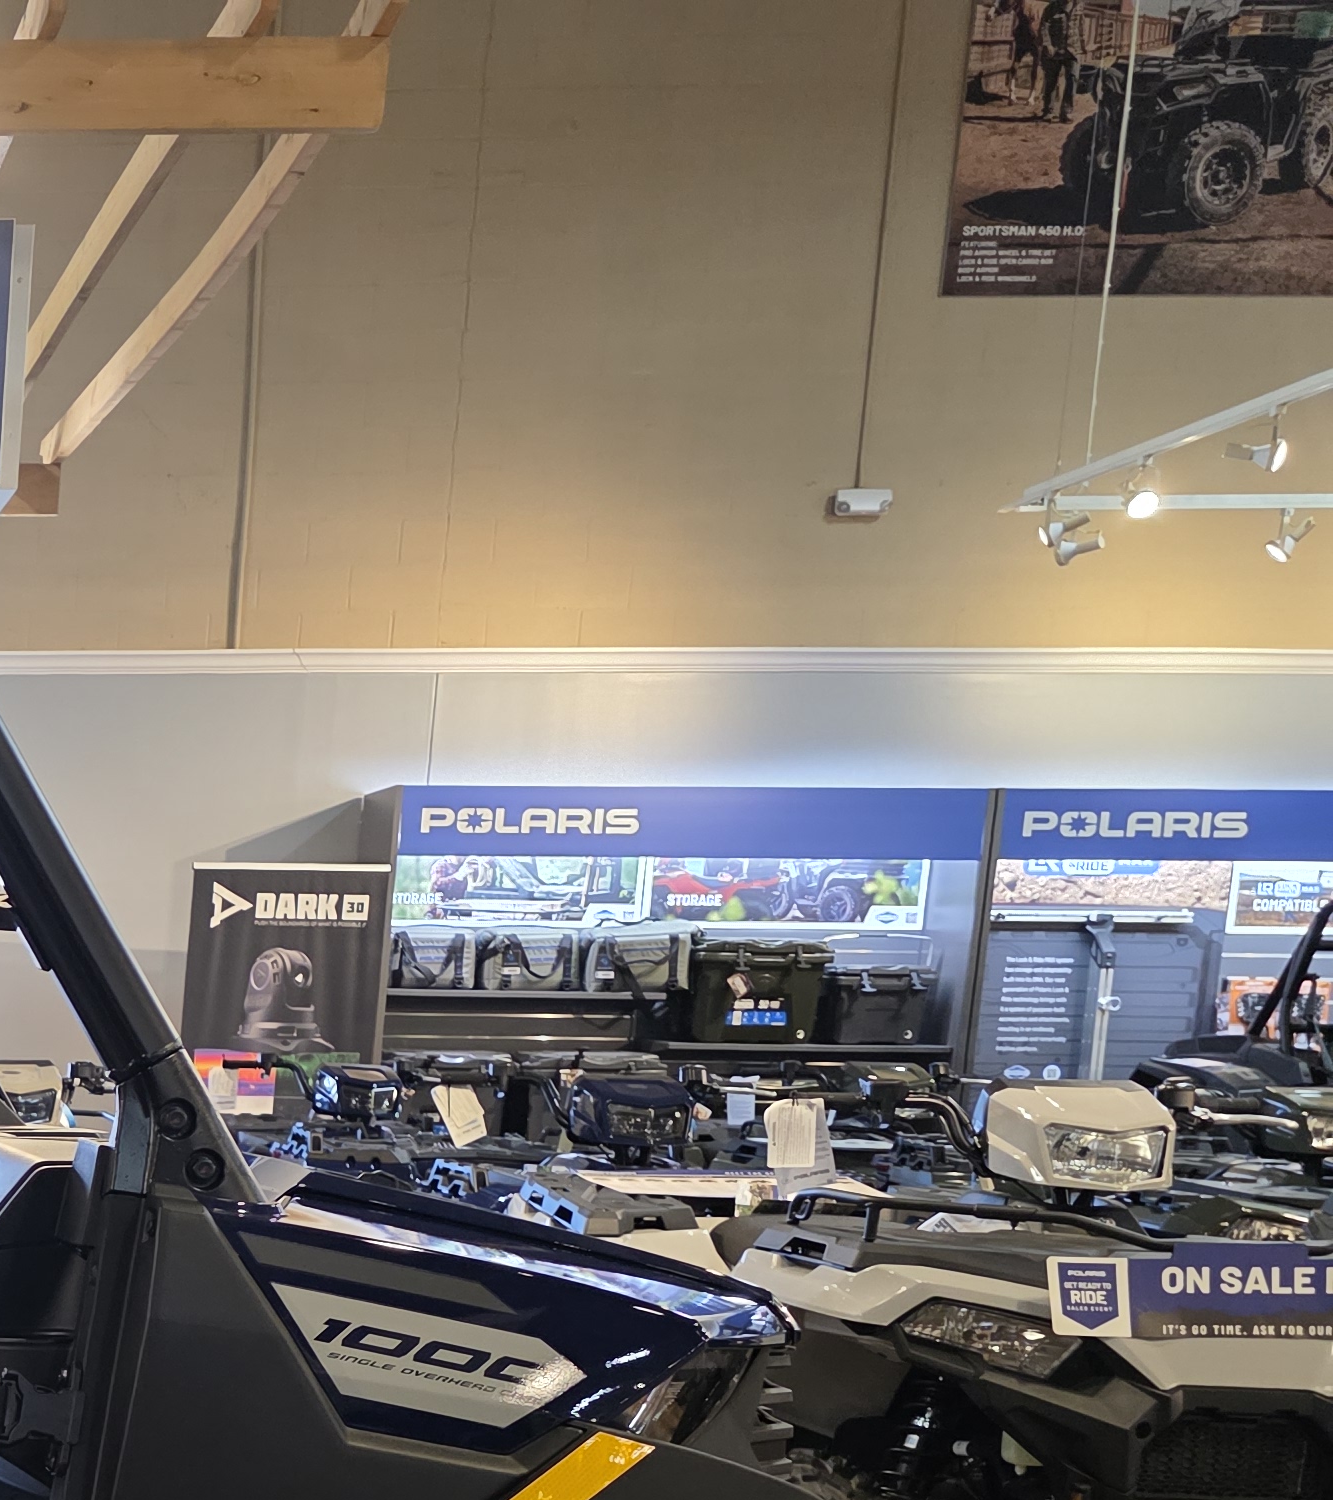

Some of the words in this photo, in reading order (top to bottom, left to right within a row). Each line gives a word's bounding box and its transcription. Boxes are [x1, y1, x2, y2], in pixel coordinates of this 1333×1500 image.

[962, 225, 1036, 236] SPORTSMAN
[1038, 225, 1061, 236] 450
[420, 807, 640, 835] POLARIS
[1022, 810, 1248, 839] POLARIS
[255, 892, 339, 920] DARK
[393, 892, 444, 905] TORAGE
[666, 894, 723, 907] STORAGE
[1161, 1266, 1210, 1294] ON
[1220, 1266, 1316, 1295] SALE
[1070, 1290, 1108, 1305] RIDE
[1162, 1324, 1188, 1335] IT'S
[1252, 1325, 1275, 1336] ASK
[1281, 1325, 1304, 1336] FOR
[327, 1351, 394, 1371] SINGLE
[400, 1366, 497, 1393] OVERHEAD
